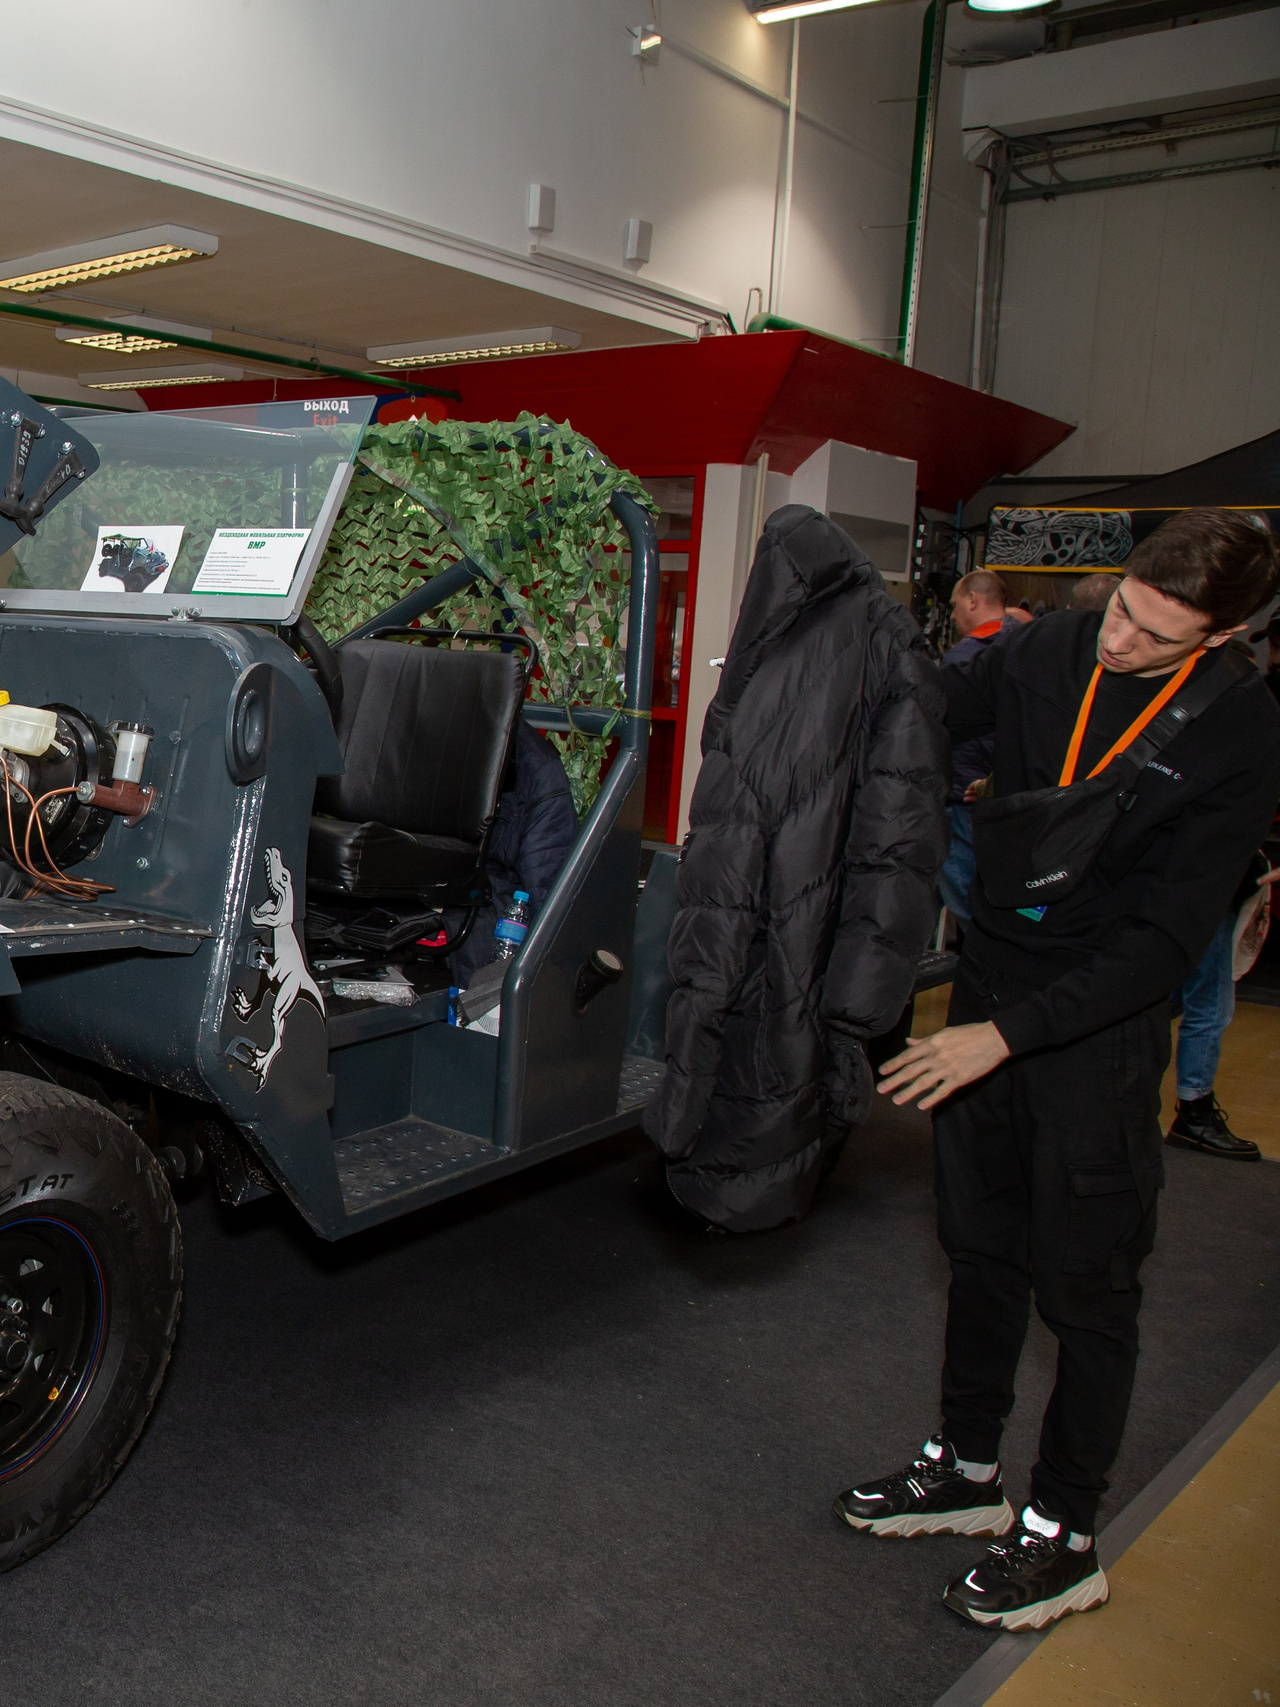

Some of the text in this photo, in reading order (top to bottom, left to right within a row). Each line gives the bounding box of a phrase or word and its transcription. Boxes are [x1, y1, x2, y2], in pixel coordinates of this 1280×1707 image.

[304, 400, 349, 414] ВЫХОД
[1025, 870, 1068, 889] Calvin Klein
